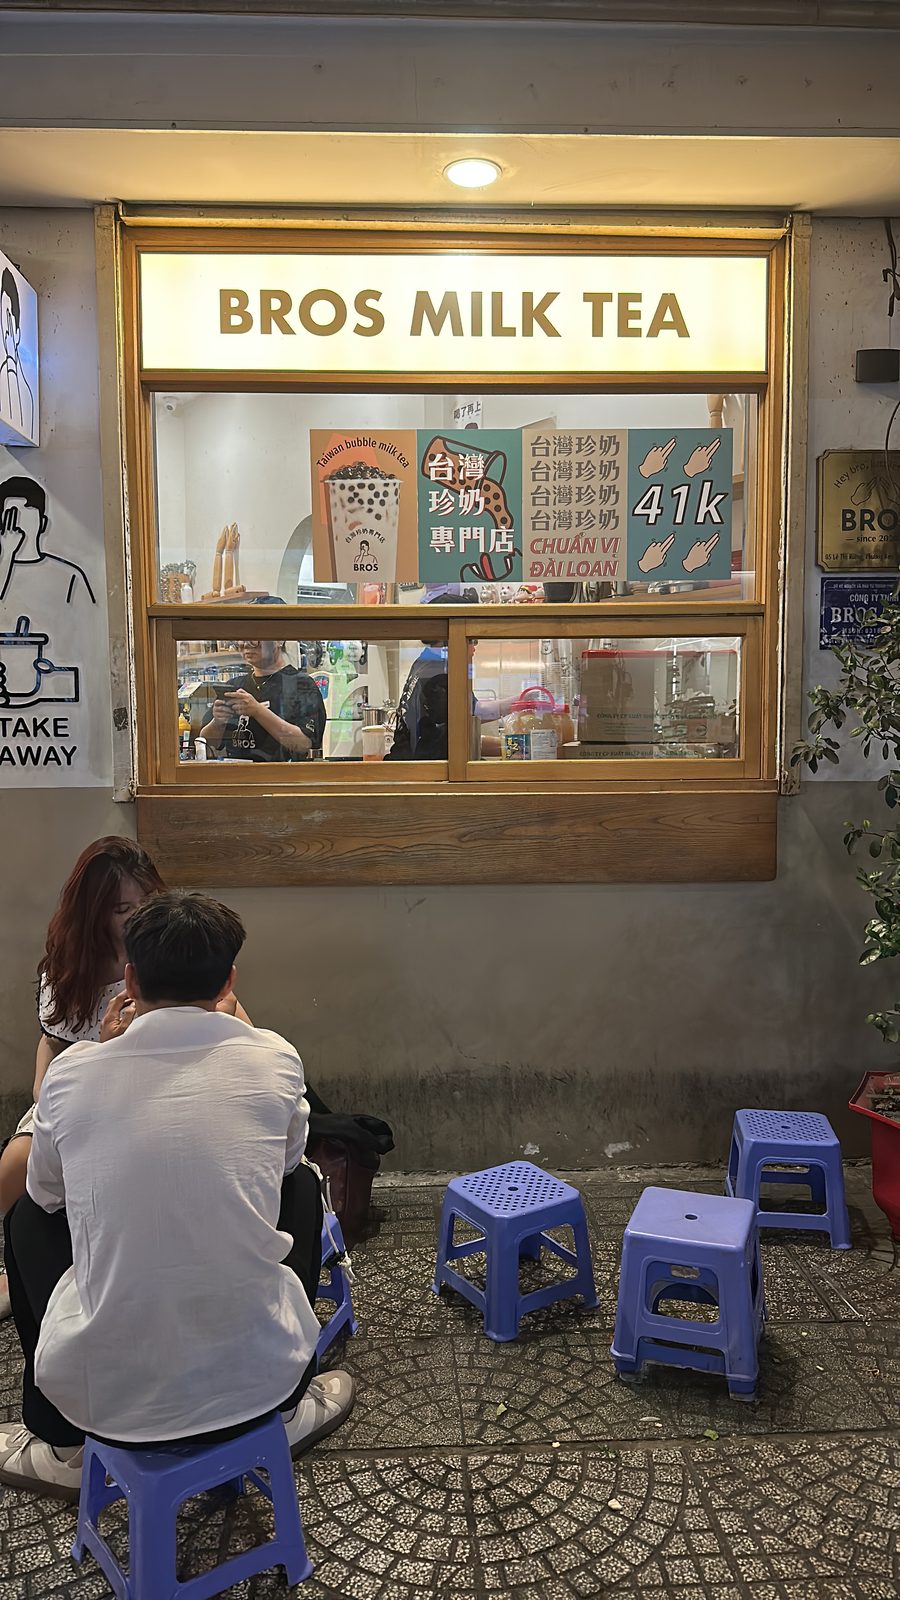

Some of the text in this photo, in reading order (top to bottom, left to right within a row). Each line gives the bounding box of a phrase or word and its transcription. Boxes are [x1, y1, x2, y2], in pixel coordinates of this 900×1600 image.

[219, 288, 690, 338] BROS MILK TEA
[316, 437, 410, 468] Taiwan bubble milk tea
[530, 435, 620, 458] 台灣珍奶
[428, 453, 486, 481] 台灣
[530, 459, 620, 482] 台灣珍奶
[833, 472, 850, 489] Hey
[849, 463, 869, 474] bro,
[428, 488, 486, 516] 珍奶
[530, 484, 620, 507] 台灣珍奶
[632, 480, 729, 525] 41k
[530, 509, 620, 532] 台灣珍奶
[429, 526, 516, 553] 專門店
[530, 532, 621, 558] CHUẨN VỊ
[856, 534, 877, 543] since
[353, 563, 379, 571] BROS
[529, 557, 618, 578] ĐÀI LOAN
[850, 593, 869, 602] CÔNG
[871, 594, 879, 602] TY
[0, 717, 70, 738] TAKE
[0, 745, 78, 766] AWAY
[232, 739, 256, 749] BROS
